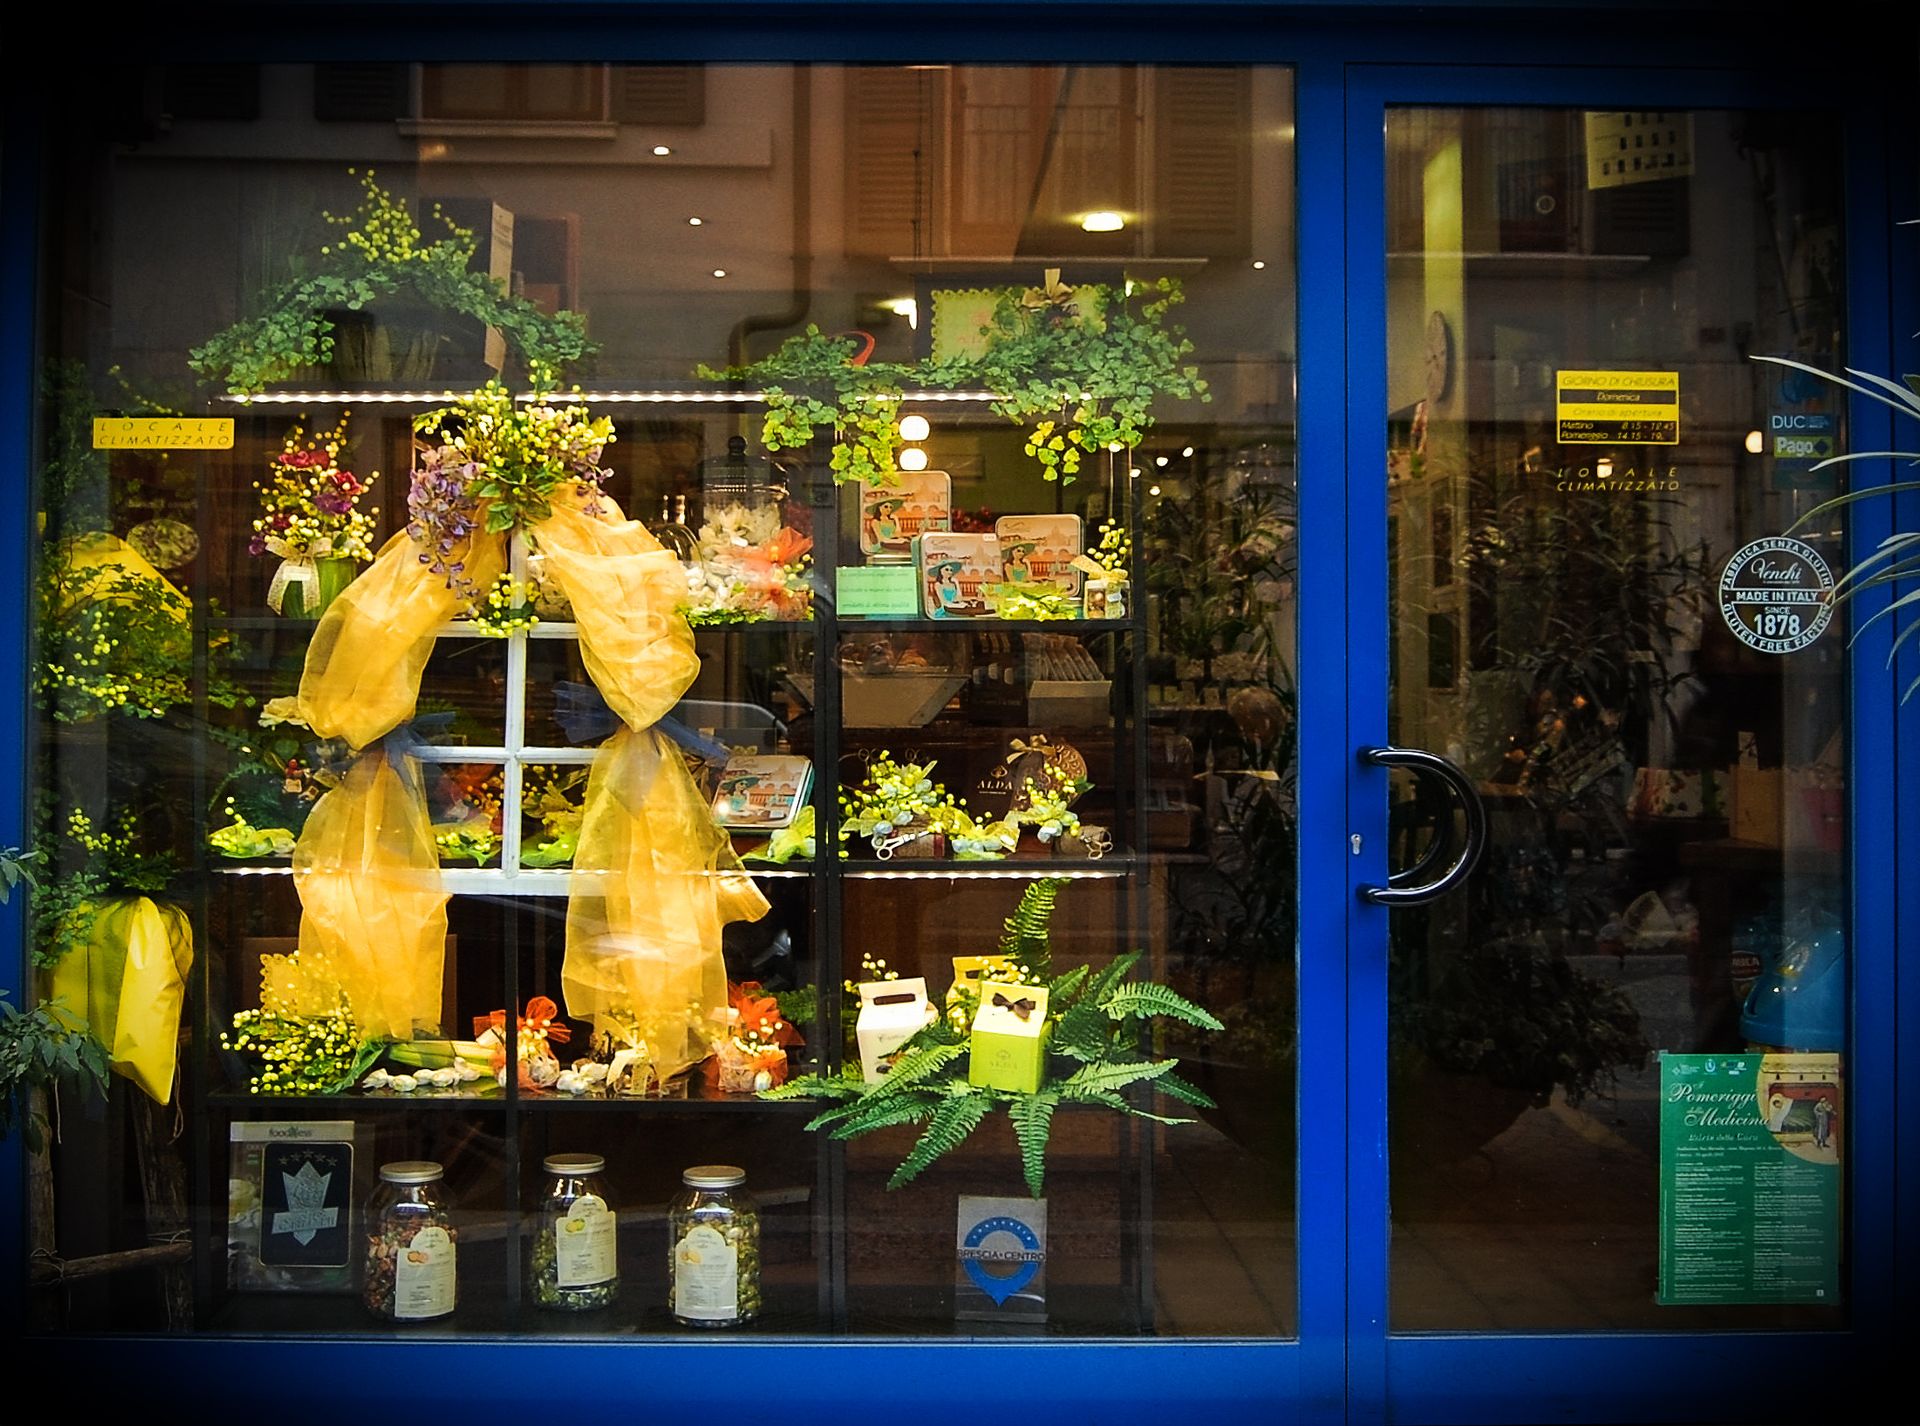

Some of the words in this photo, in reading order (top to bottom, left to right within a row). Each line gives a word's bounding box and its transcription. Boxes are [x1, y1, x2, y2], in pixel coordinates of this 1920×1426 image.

[1563, 376, 1607, 386] GIORNO
[1609, 376, 1620, 386] DI
[1597, 392, 1641, 402] Domenica
[101, 421, 228, 432] LOCALE
[1561, 421, 1594, 431] Mattino
[1772, 415, 1806, 429] DUC
[99, 435, 230, 446] CLIMATIZZATO
[1776, 437, 1814, 457] Pago
[1557, 467, 1678, 479] LOALE
[1557, 481, 1680, 492] CLIMATIZZATO
[1722, 545, 1760, 590] FABBRICA
[1762, 539, 1799, 552] SENZA
[1802, 549, 1833, 590] GLUTINE
[1751, 557, 1802, 580] Venchi
[1736, 591, 1769, 602] MADE
[1772, 591, 1784, 602] IN
[1787, 591, 1819, 602] ITALY
[1764, 606, 1791, 615] SINCE
[1722, 603, 1757, 644] GLUTEN
[1758, 640, 1792, 652] FREE
[1794, 604, 1831, 649] FACTORY
[1753, 613, 1800, 636] 1878
[1668, 1082, 1758, 1109] Pomeriggi
[1684, 1108, 1770, 1128] Medicina
